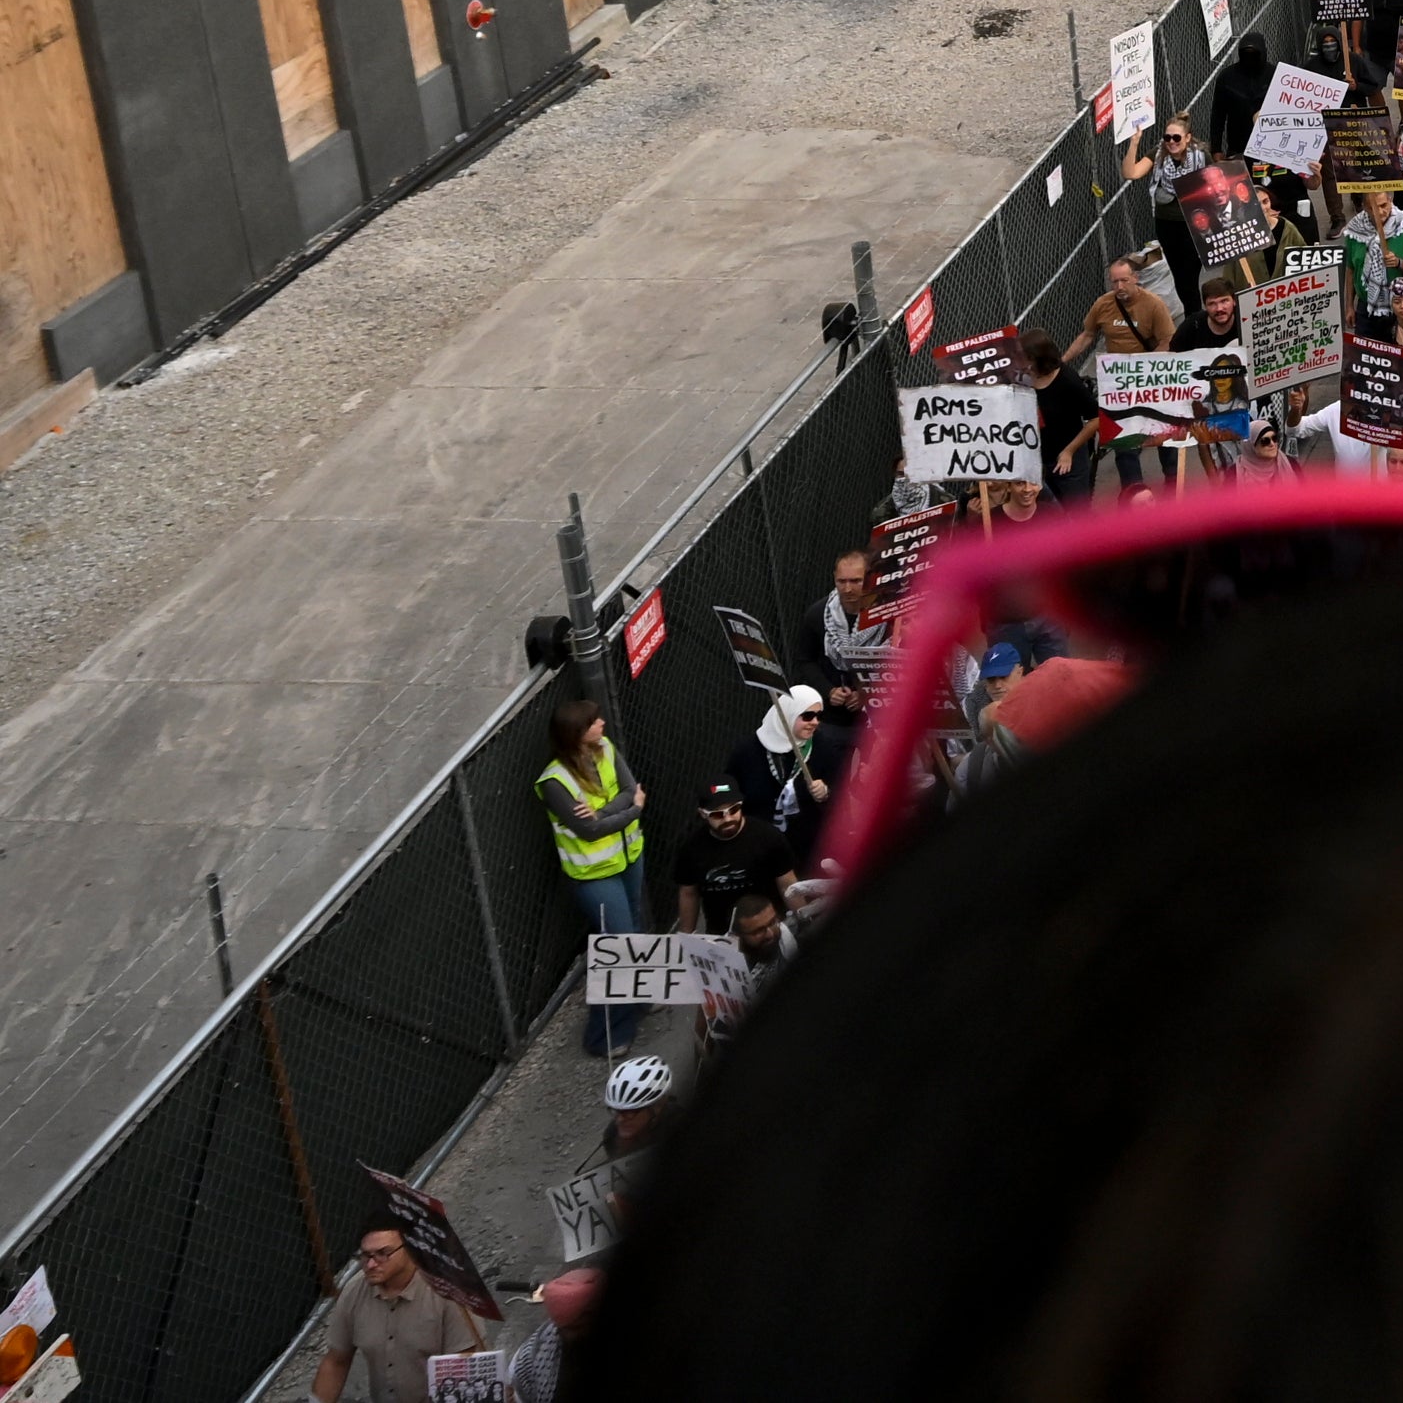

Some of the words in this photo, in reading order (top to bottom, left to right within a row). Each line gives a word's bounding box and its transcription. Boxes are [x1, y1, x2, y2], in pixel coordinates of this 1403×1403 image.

[1122, 49, 1141, 67] FREE
[1123, 65, 1142, 78] UNTIL
[1281, 74, 1341, 102] GENOCIDE
[1124, 97, 1142, 115] FREE
[1279, 92, 1292, 105] IN
[1261, 117, 1289, 127] MADE
[1293, 118, 1303, 126] IN
[1286, 249, 1344, 265] CEASE
[1255, 274, 1330, 307] ISRAEL:
[1252, 305, 1276, 320] Killed
[1279, 300, 1292, 311] 38
[1295, 290, 1338, 307] Palestinian
[1252, 314, 1286, 330] children
[1291, 310, 1299, 319] in
[1302, 299, 1331, 315] 2023
[1280, 343, 1308, 357] YOUR
[1102, 361, 1144, 374] WHILE
[1148, 359, 1193, 372] YOU'RE
[1115, 372, 1189, 390] SPEAKING
[1101, 391, 1132, 406] THEY
[1135, 389, 1159, 404] ARE
[1162, 386, 1202, 402] DYING
[914, 396, 983, 420] ARMS
[923, 421, 1038, 450] EMBARGO
[947, 449, 1014, 476] NOW
